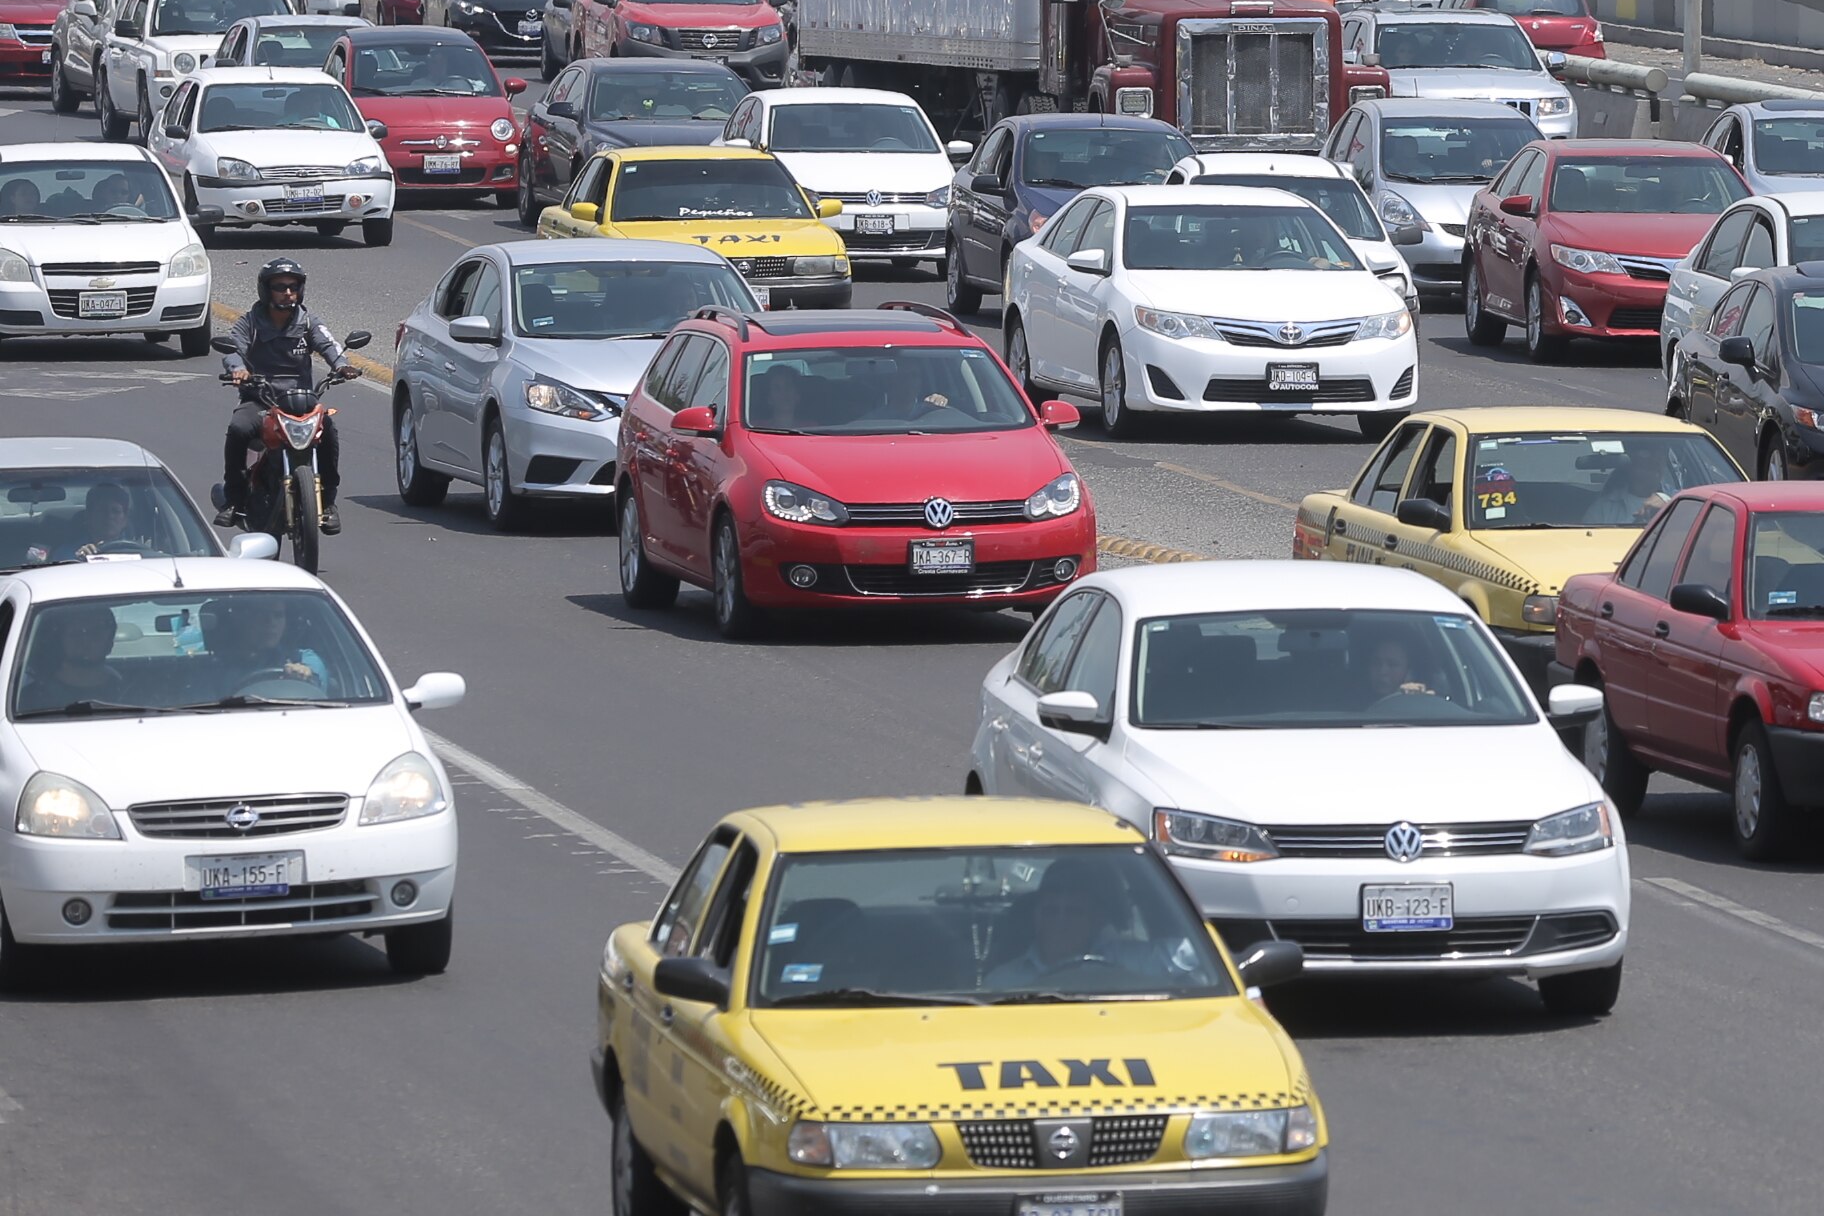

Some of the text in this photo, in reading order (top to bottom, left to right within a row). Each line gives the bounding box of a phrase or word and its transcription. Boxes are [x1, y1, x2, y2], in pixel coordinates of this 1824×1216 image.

[679, 207, 753, 217] Pequeños
[691, 235, 780, 244] TAXI
[1478, 491, 1517, 509] 734
[203, 864, 284, 887] UKA-155-F
[1367, 897, 1448, 917] UKB-123-F
[937, 1059, 1157, 1090] TAXI
